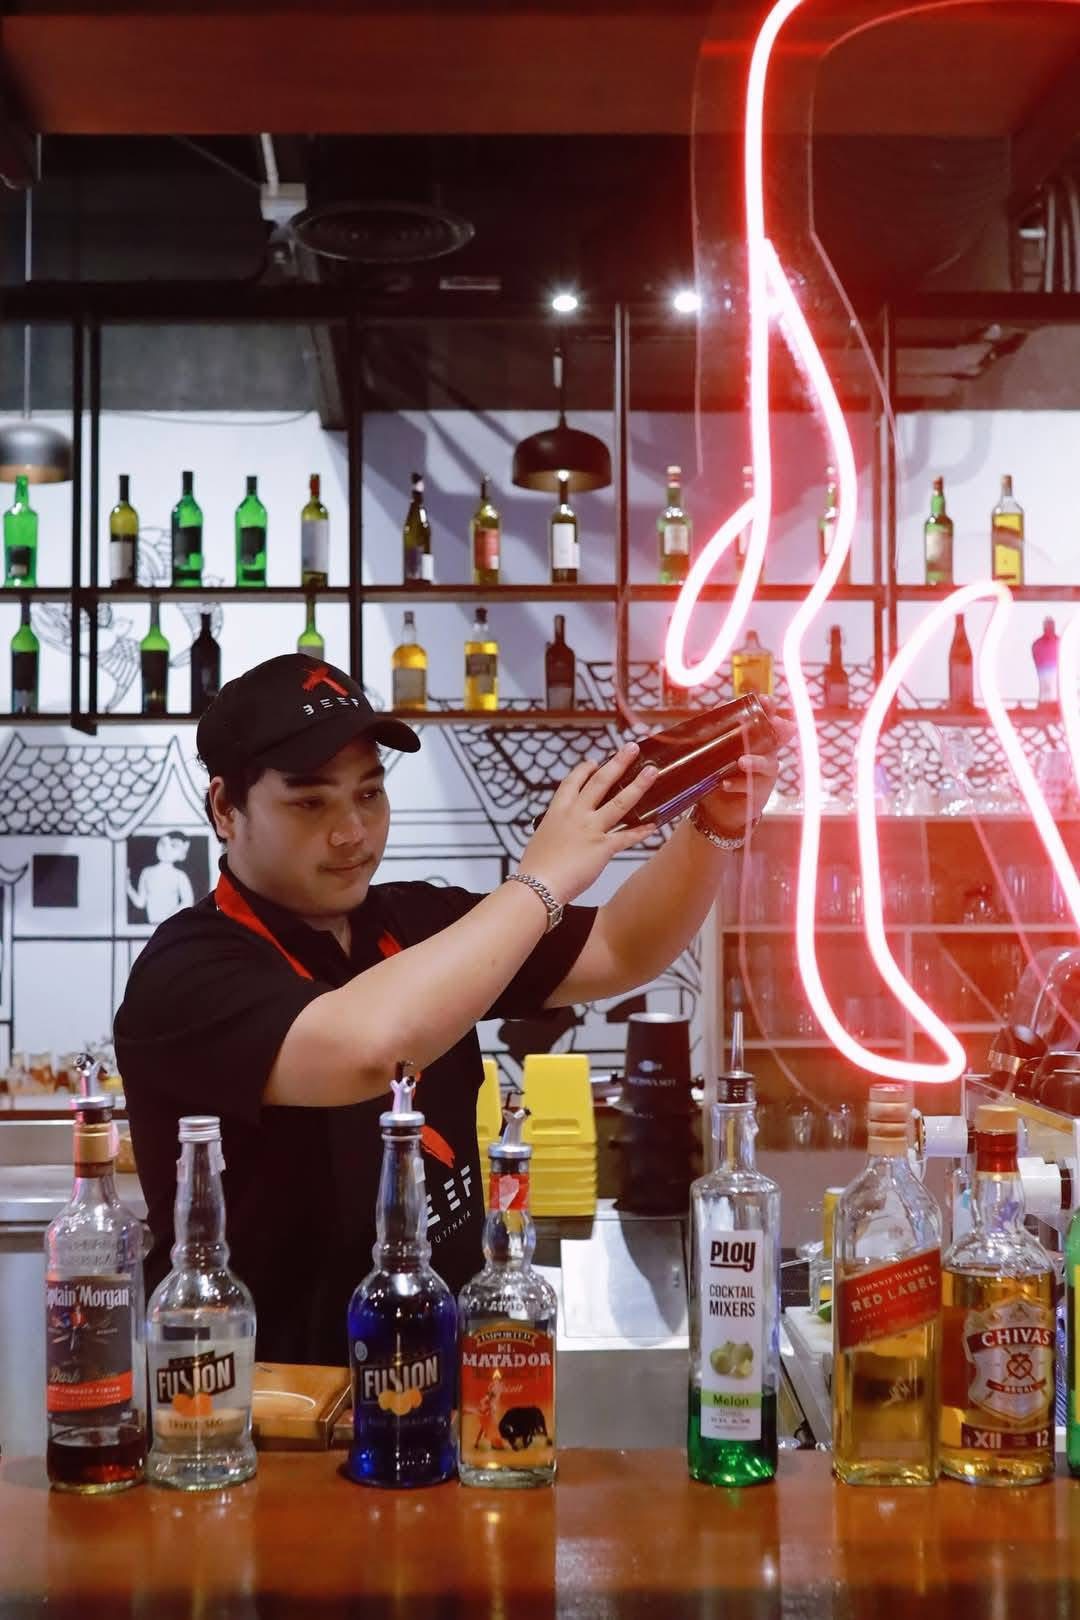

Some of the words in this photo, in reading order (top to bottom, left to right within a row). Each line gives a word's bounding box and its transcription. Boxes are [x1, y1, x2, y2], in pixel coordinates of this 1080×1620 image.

[79, 1285, 129, 1309] Morgan
[709, 1284, 755, 1299] COCKTAIL
[851, 1293, 883, 1312] RED
[887, 1275, 937, 1300] LABEL
[709, 1299, 756, 1318] MIXERS
[981, 1328, 1051, 1347] CHIVAS
[462, 1352, 551, 1368] MATADOR
[158, 1358, 232, 1401] FUSION
[364, 1355, 438, 1399] FUSION
[713, 1393, 750, 1407] Melon
[974, 1431, 1002, 1449] XII
[1036, 1429, 1049, 1448] 12
